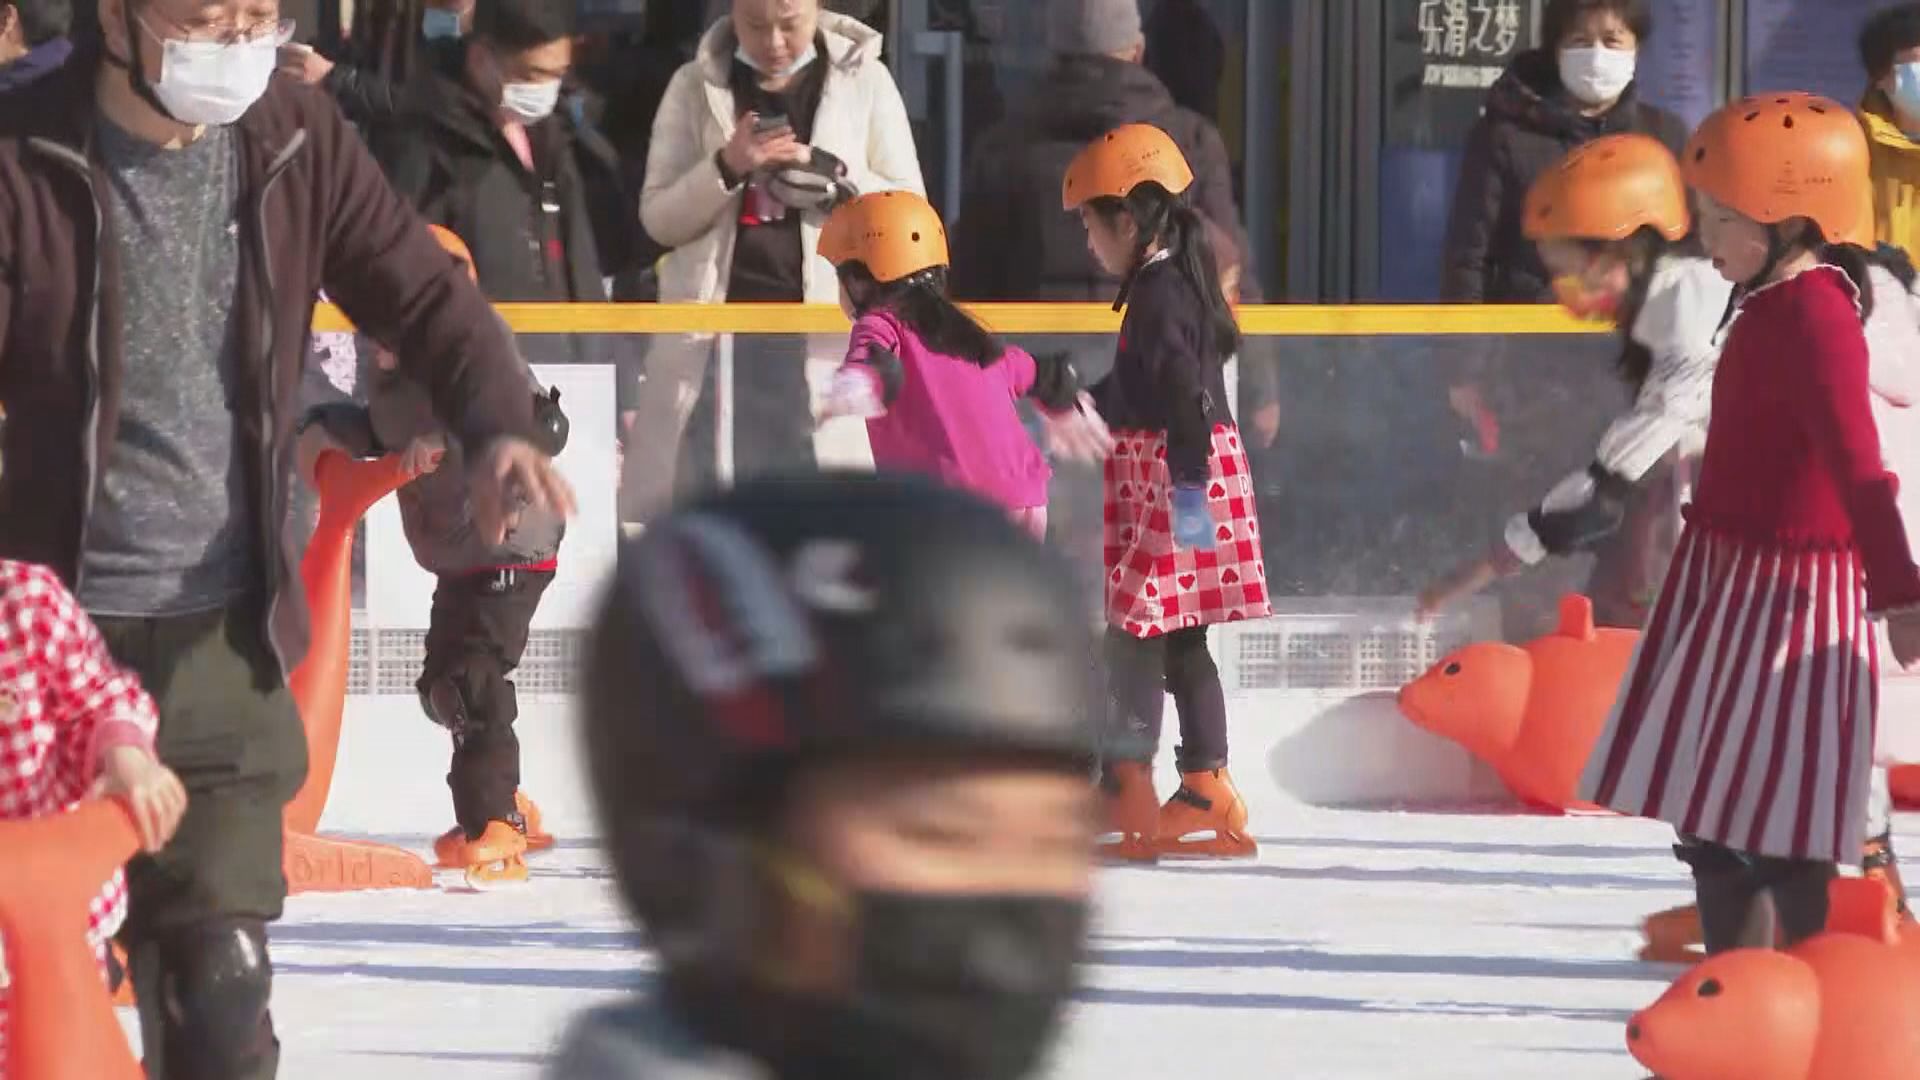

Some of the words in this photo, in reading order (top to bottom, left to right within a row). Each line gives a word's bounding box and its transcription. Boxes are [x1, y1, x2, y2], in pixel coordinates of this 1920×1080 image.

[1418, 0, 1520, 57] 乐滑之梦
[293, 846, 373, 884] orld
